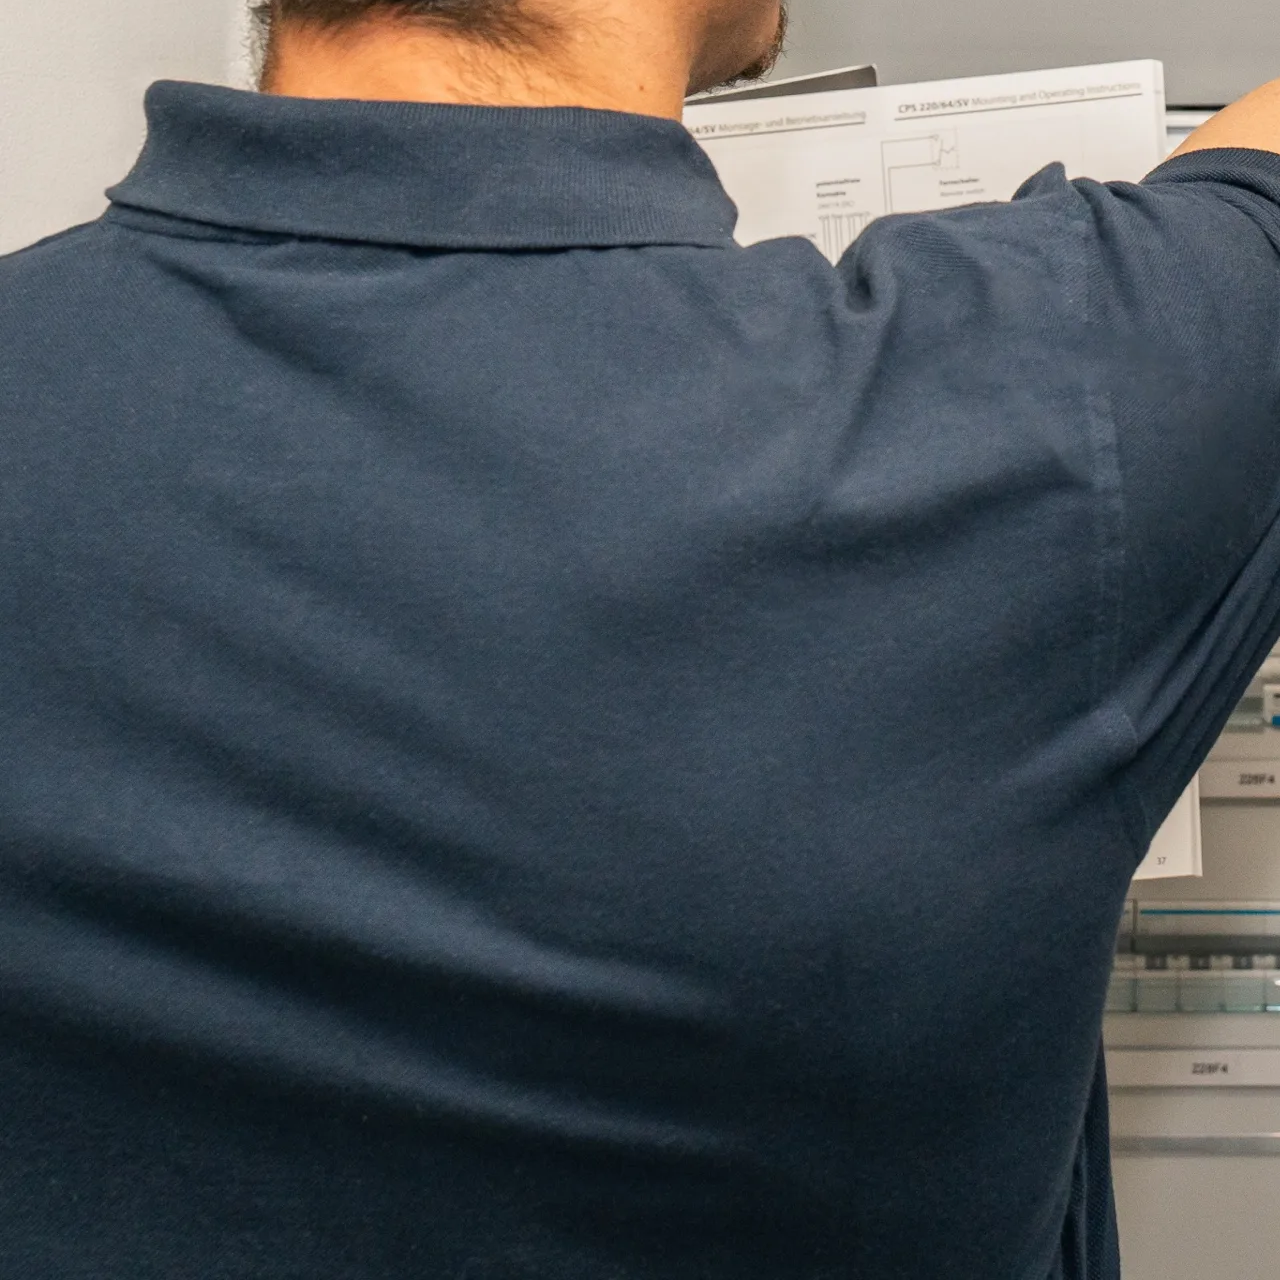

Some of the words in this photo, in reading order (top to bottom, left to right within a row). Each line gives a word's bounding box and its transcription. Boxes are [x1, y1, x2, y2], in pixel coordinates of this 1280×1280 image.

[898, 103, 917, 114] CPS
[920, 98, 970, 112] 220/64/SV
[971, 93, 1017, 105] Mounting
[1019, 91, 1036, 101] and
[1038, 86, 1085, 99] Operating
[1086, 82, 1141, 94] Instructions
[765, 117, 784, 127] und
[1156, 856, 1167, 866] 37
